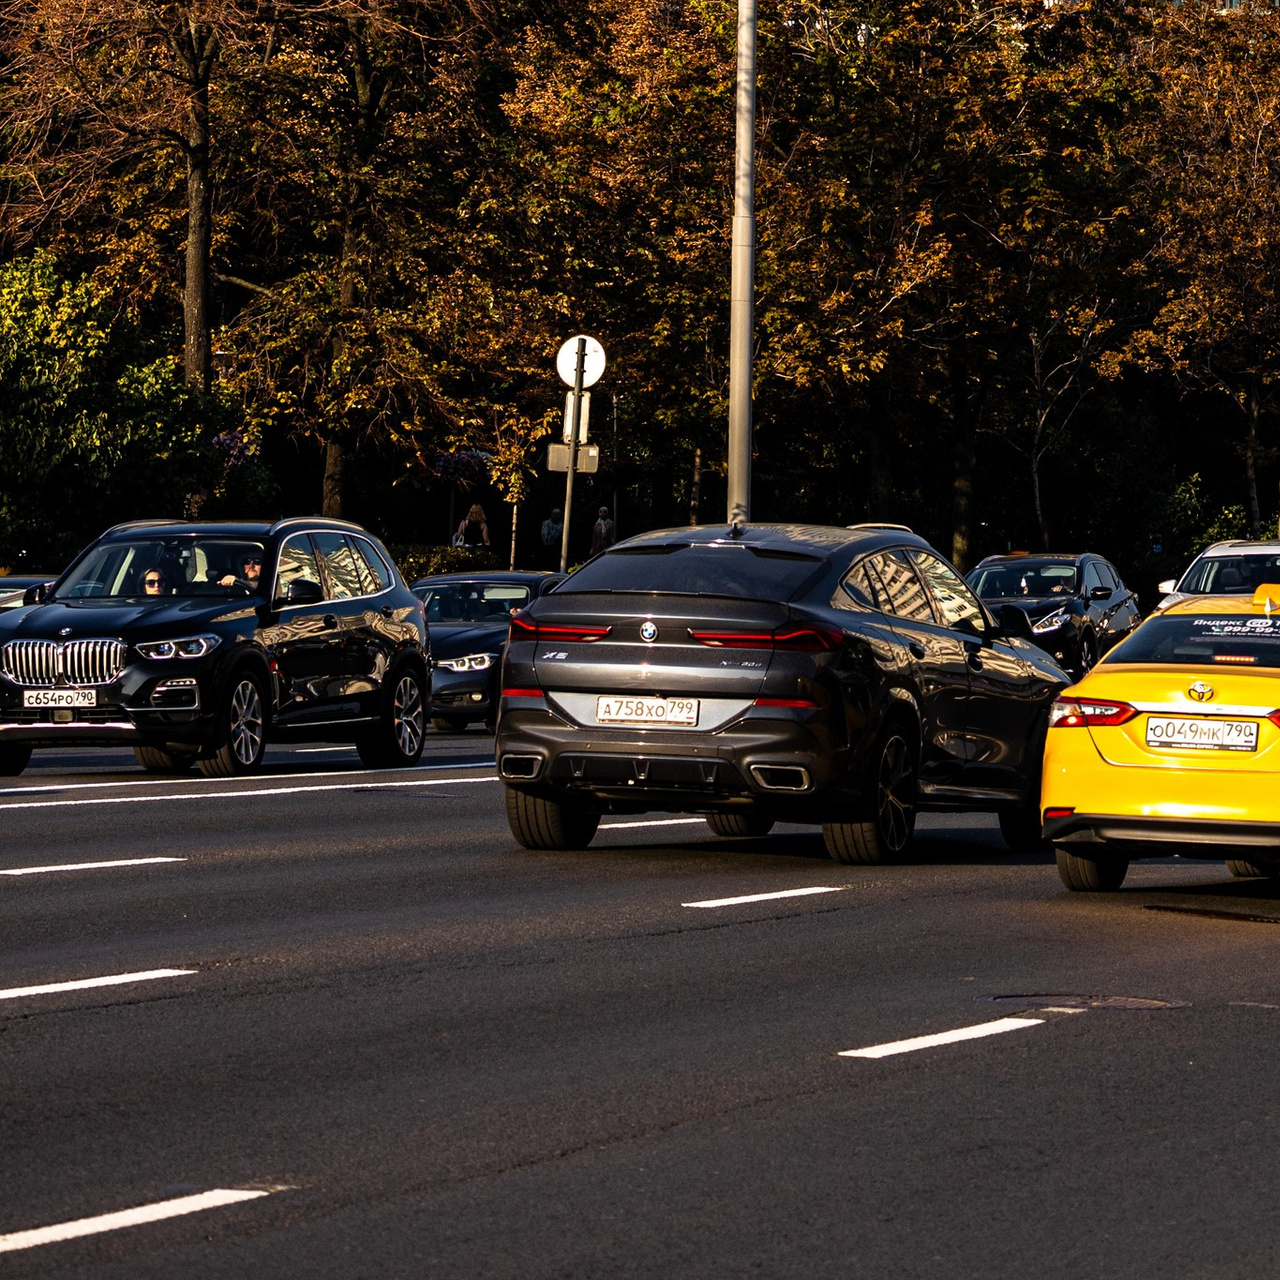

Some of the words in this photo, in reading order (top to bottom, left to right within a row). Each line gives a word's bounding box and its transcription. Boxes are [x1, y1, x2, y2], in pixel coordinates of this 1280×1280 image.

[1193, 619, 1244, 627] Яндекс
[27, 692, 73, 705] С654РО
[75, 692, 93, 701] 790
[603, 700, 665, 717] А758ХО
[669, 700, 693, 714] 799
[1153, 721, 1221, 740] О049МК
[1226, 723, 1252, 737] 790
